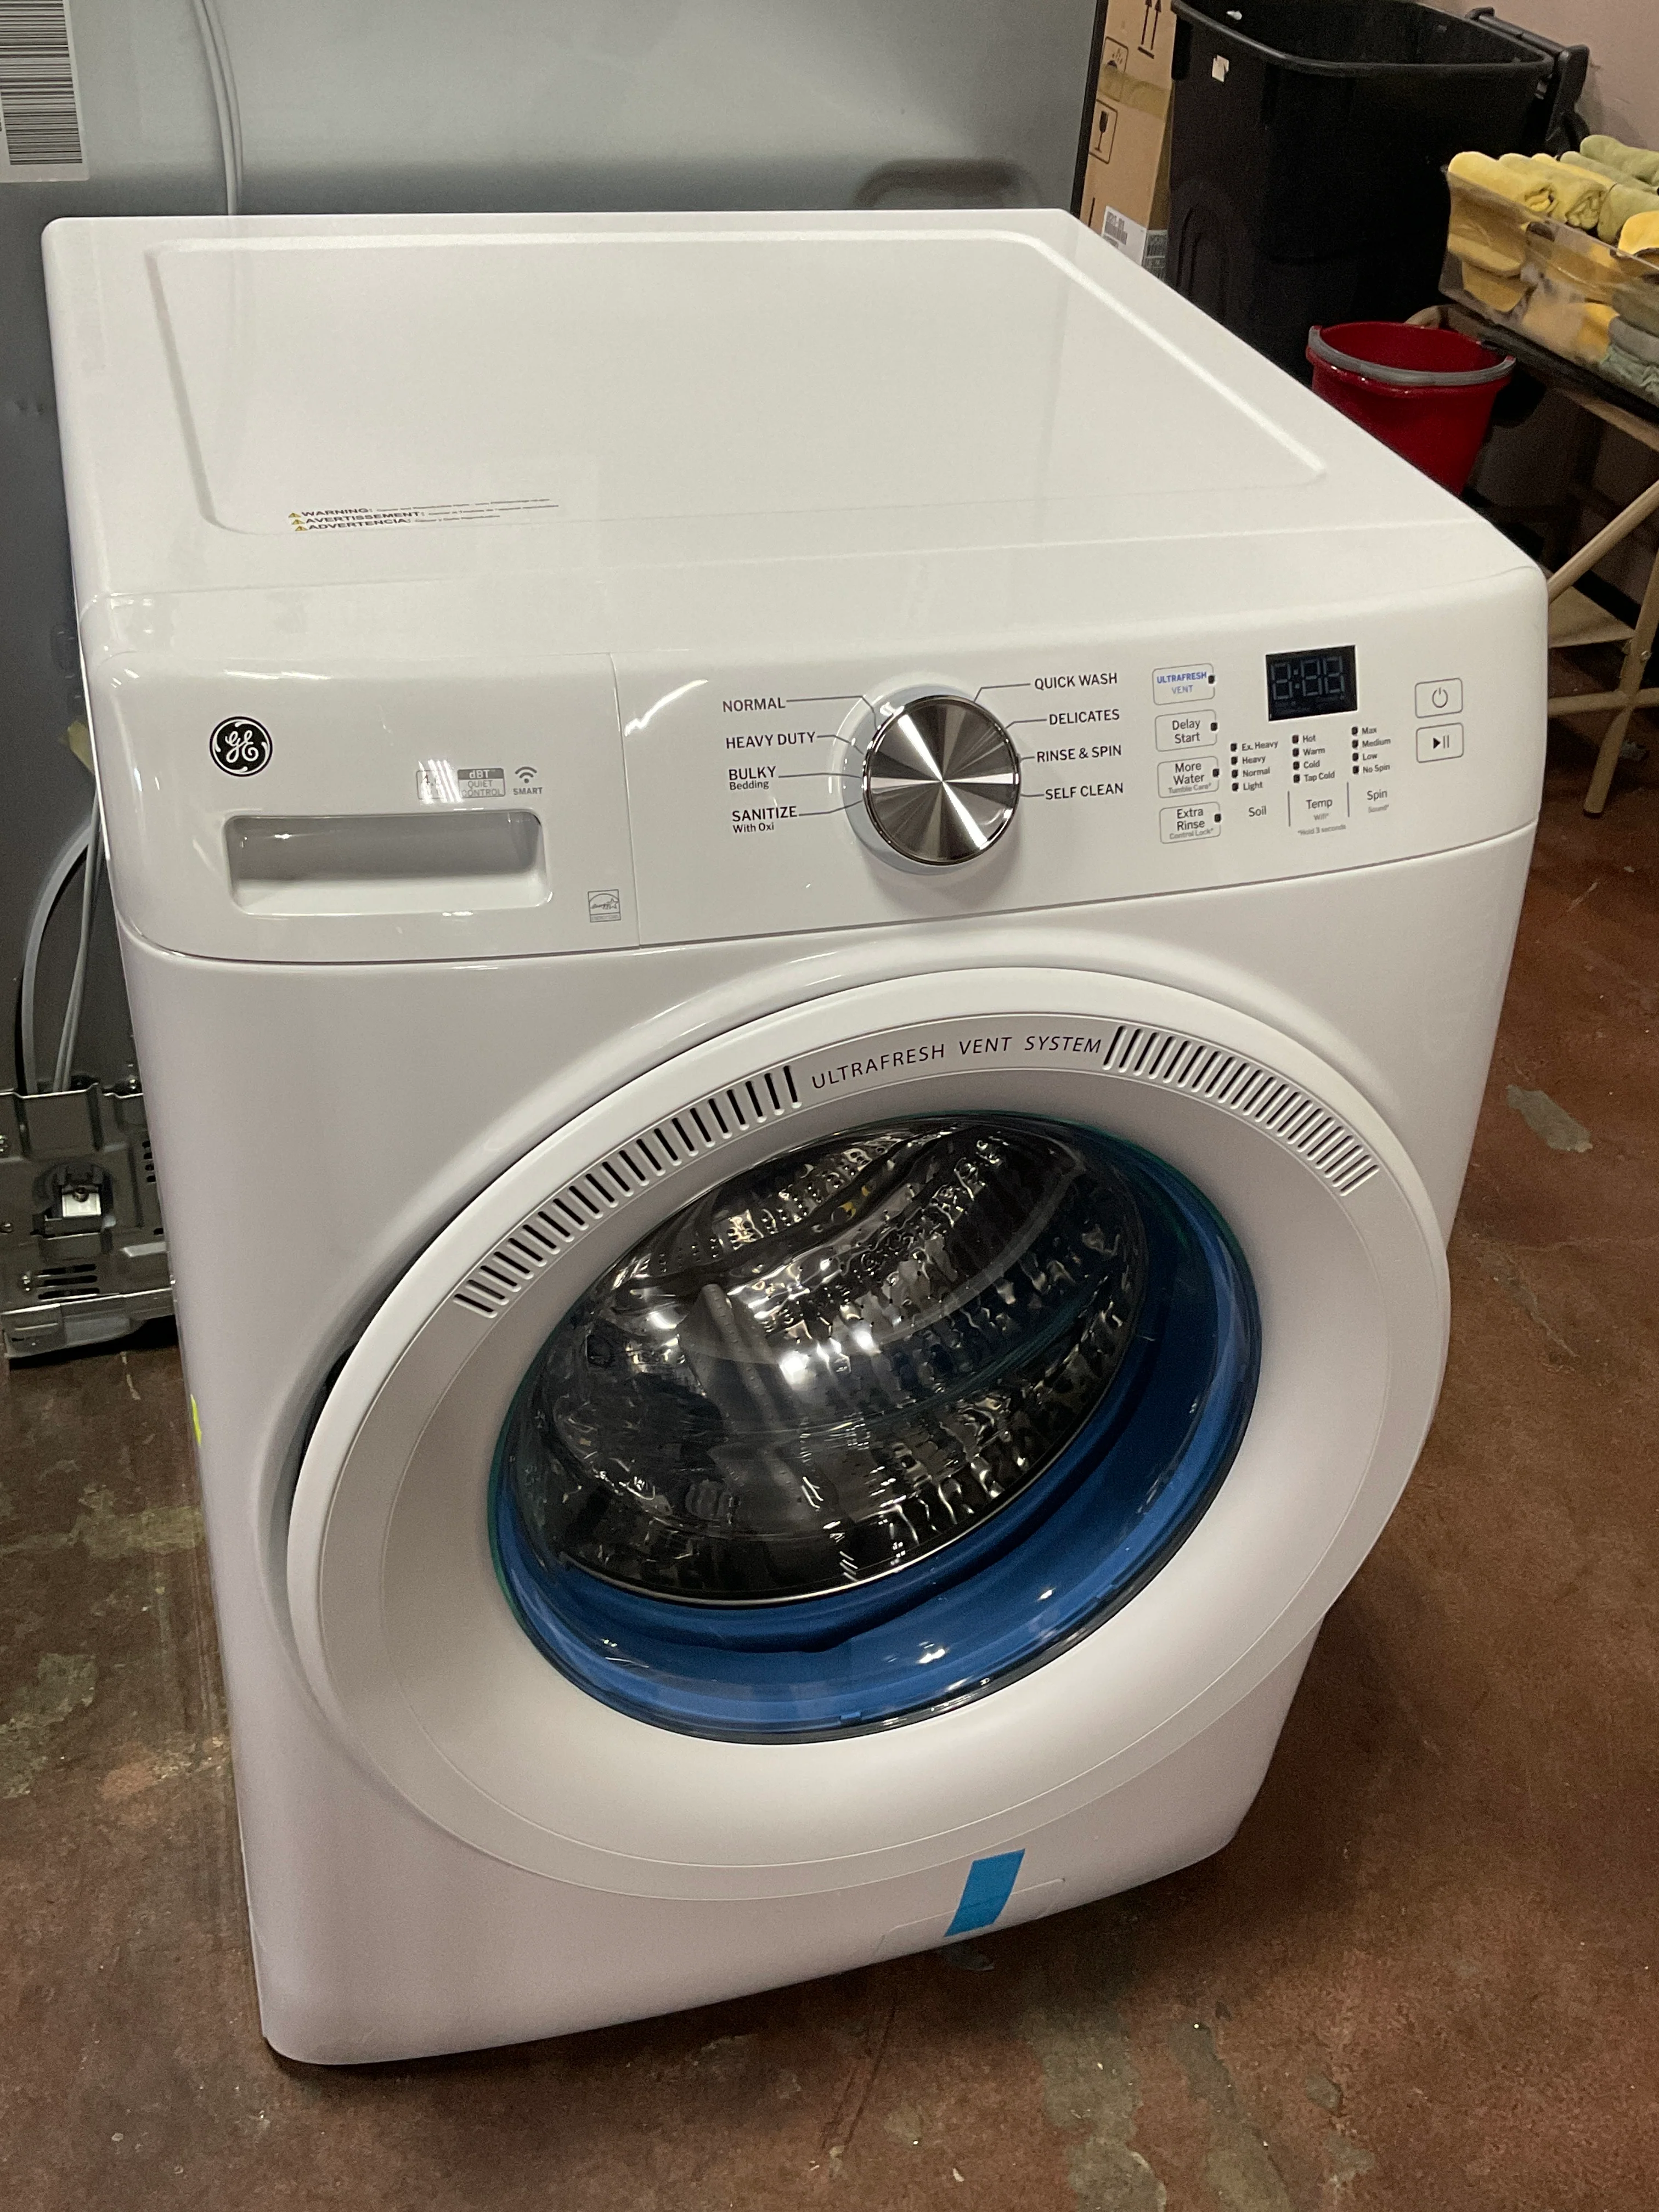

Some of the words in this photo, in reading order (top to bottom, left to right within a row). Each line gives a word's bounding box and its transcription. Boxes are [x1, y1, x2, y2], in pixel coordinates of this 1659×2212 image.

[1035, 675, 1075, 691] QUICK
[1079, 673, 1118, 686] WASH
[1156, 672, 1207, 684] ULTRAFRESH
[1171, 685, 1193, 694] VENT
[723, 697, 786, 712] NORMAL
[1049, 709, 1120, 725] DELICATES
[1172, 719, 1200, 730] Delay
[726, 734, 774, 749] HEAVY
[777, 731, 815, 745] DUTY
[1175, 732, 1200, 744] Start
[1302, 734, 1316, 743] Hot
[1362, 738, 1391, 748] Medium
[1255, 741, 1278, 749] Heavy
[1037, 748, 1075, 763] RINSE
[1079, 747, 1088, 759] &
[1092, 744, 1121, 758] SPIN
[1302, 748, 1325, 756] Warm
[1242, 755, 1266, 764] Heavy
[1304, 760, 1320, 769] Cold
[729, 766, 776, 780] BULKY
[1175, 763, 1201, 773] More
[1243, 766, 1270, 777] Normal
[1374, 764, 1390, 772] Spin
[1173, 774, 1204, 785] Water
[1304, 774, 1317, 782] Tap
[1318, 770, 1335, 780] Cold
[467, 780, 493, 789] QUIET
[729, 780, 769, 790] Bedding
[1243, 781, 1263, 791] Light
[460, 788, 503, 797] CONTROL
[513, 787, 543, 795] SMART
[1046, 787, 1077, 800] SELF
[1080, 782, 1124, 797] CLEAN
[1367, 789, 1387, 801] Spin
[1306, 799, 1333, 809] Temp
[732, 806, 797, 822] SANITIZE
[1177, 808, 1204, 819] Extra
[1248, 805, 1267, 817] Soil
[732, 823, 756, 833] With
[758, 822, 774, 831] Oxi
[1177, 820, 1205, 831] Rinse
[812, 1044, 944, 1090] ULTRAFRESH
[959, 1037, 1012, 1055] VENT
[1024, 1036, 1102, 1053] SYSTEM
